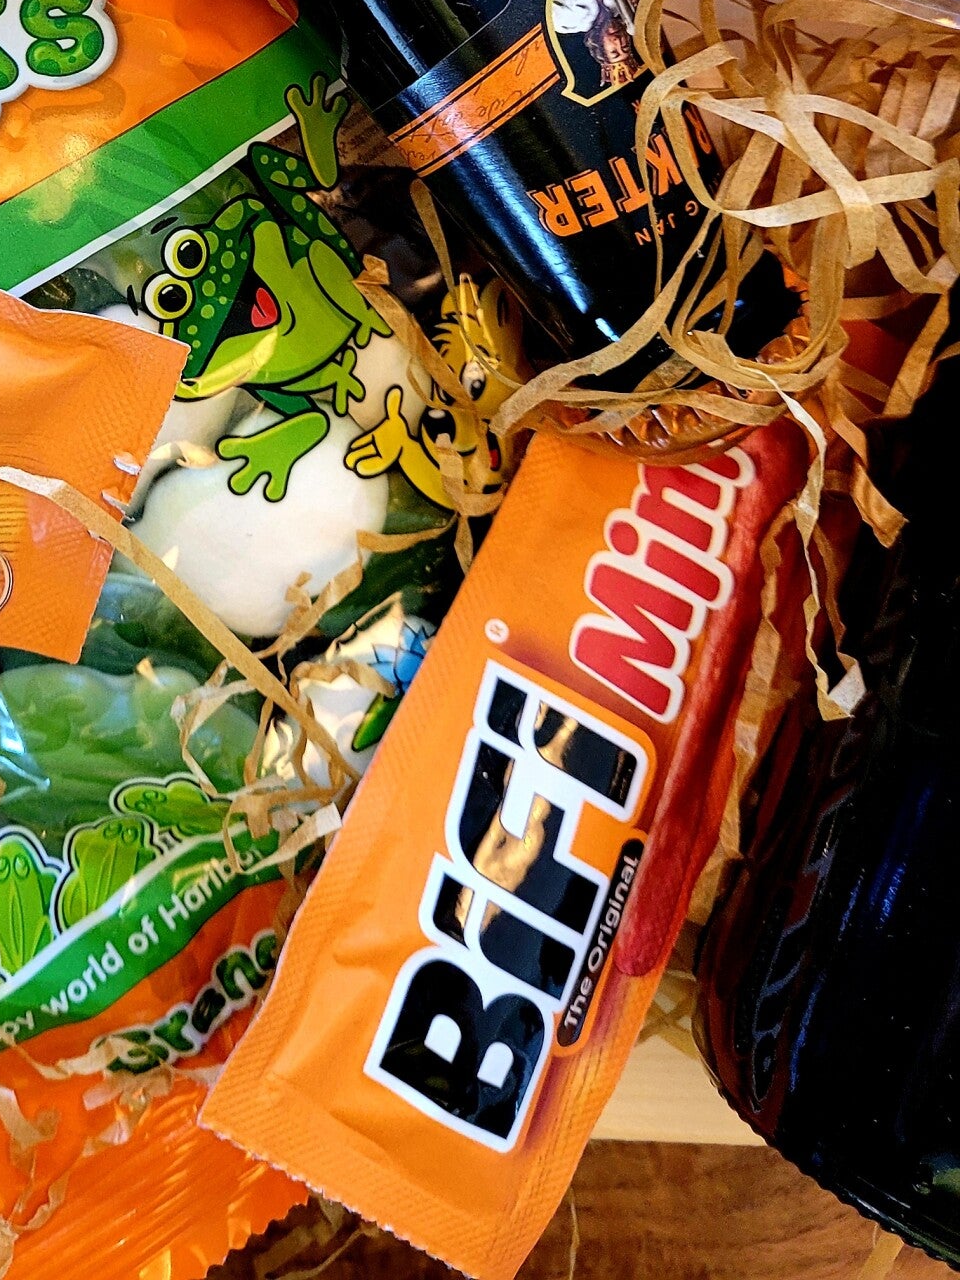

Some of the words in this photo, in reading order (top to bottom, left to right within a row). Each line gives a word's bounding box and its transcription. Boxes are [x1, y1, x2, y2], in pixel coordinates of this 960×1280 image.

[41, 940, 125, 1017] world
[128, 914, 160, 956] of
[365, 662, 654, 1152] BiFi
[564, 976, 593, 1029] The
[588, 854, 639, 974] Original
